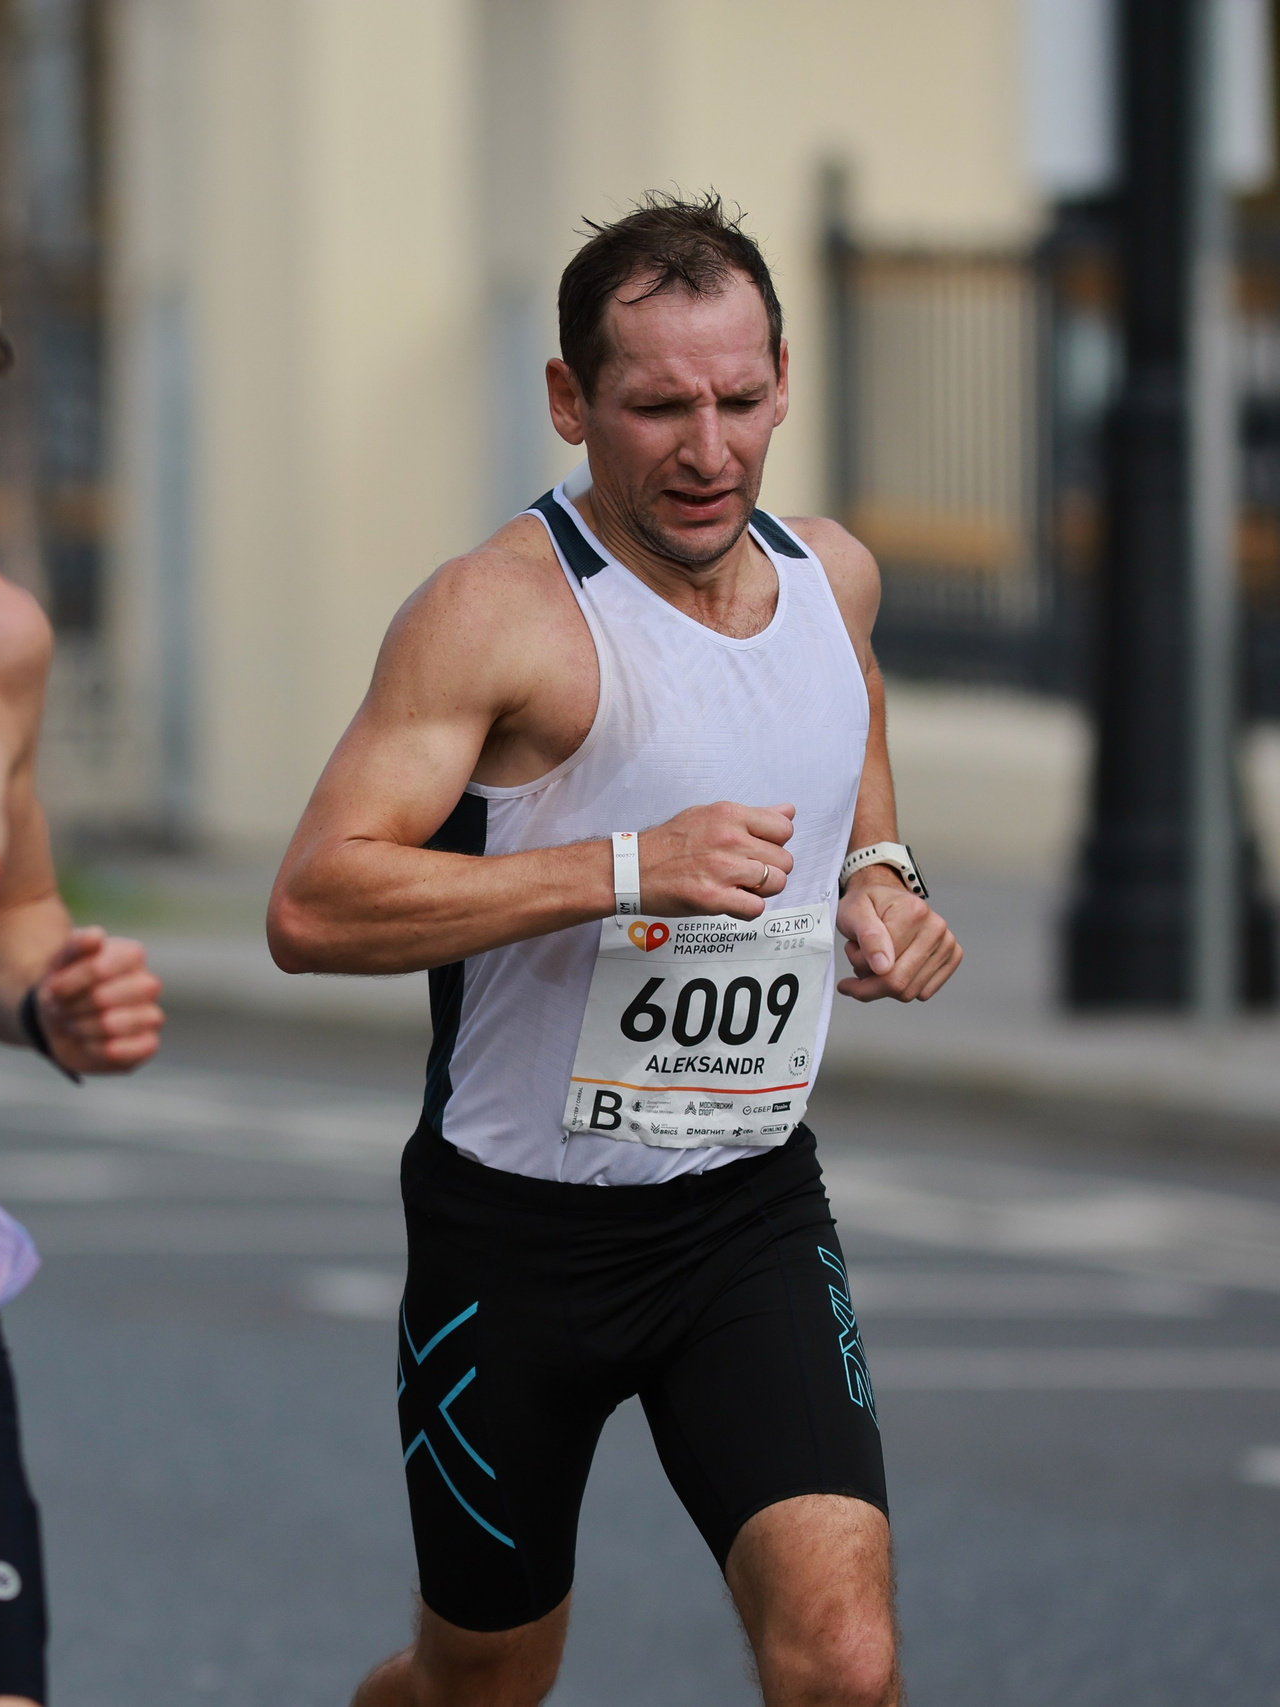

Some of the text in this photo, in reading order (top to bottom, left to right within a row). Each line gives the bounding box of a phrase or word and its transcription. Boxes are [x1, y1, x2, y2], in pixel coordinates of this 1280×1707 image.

[677, 922, 737, 931] СБЕРПРАЙМ
[770, 921, 790, 933] 42,2
[675, 930, 757, 943] МОСКОВСКИЙ
[674, 943, 734, 955] МАРАФОН
[620, 973, 799, 1047] 6009
[645, 1055, 765, 1075] ALEKSANDR
[793, 1055, 805, 1067] 13
[753, 1105, 771, 1114] СБЕР
